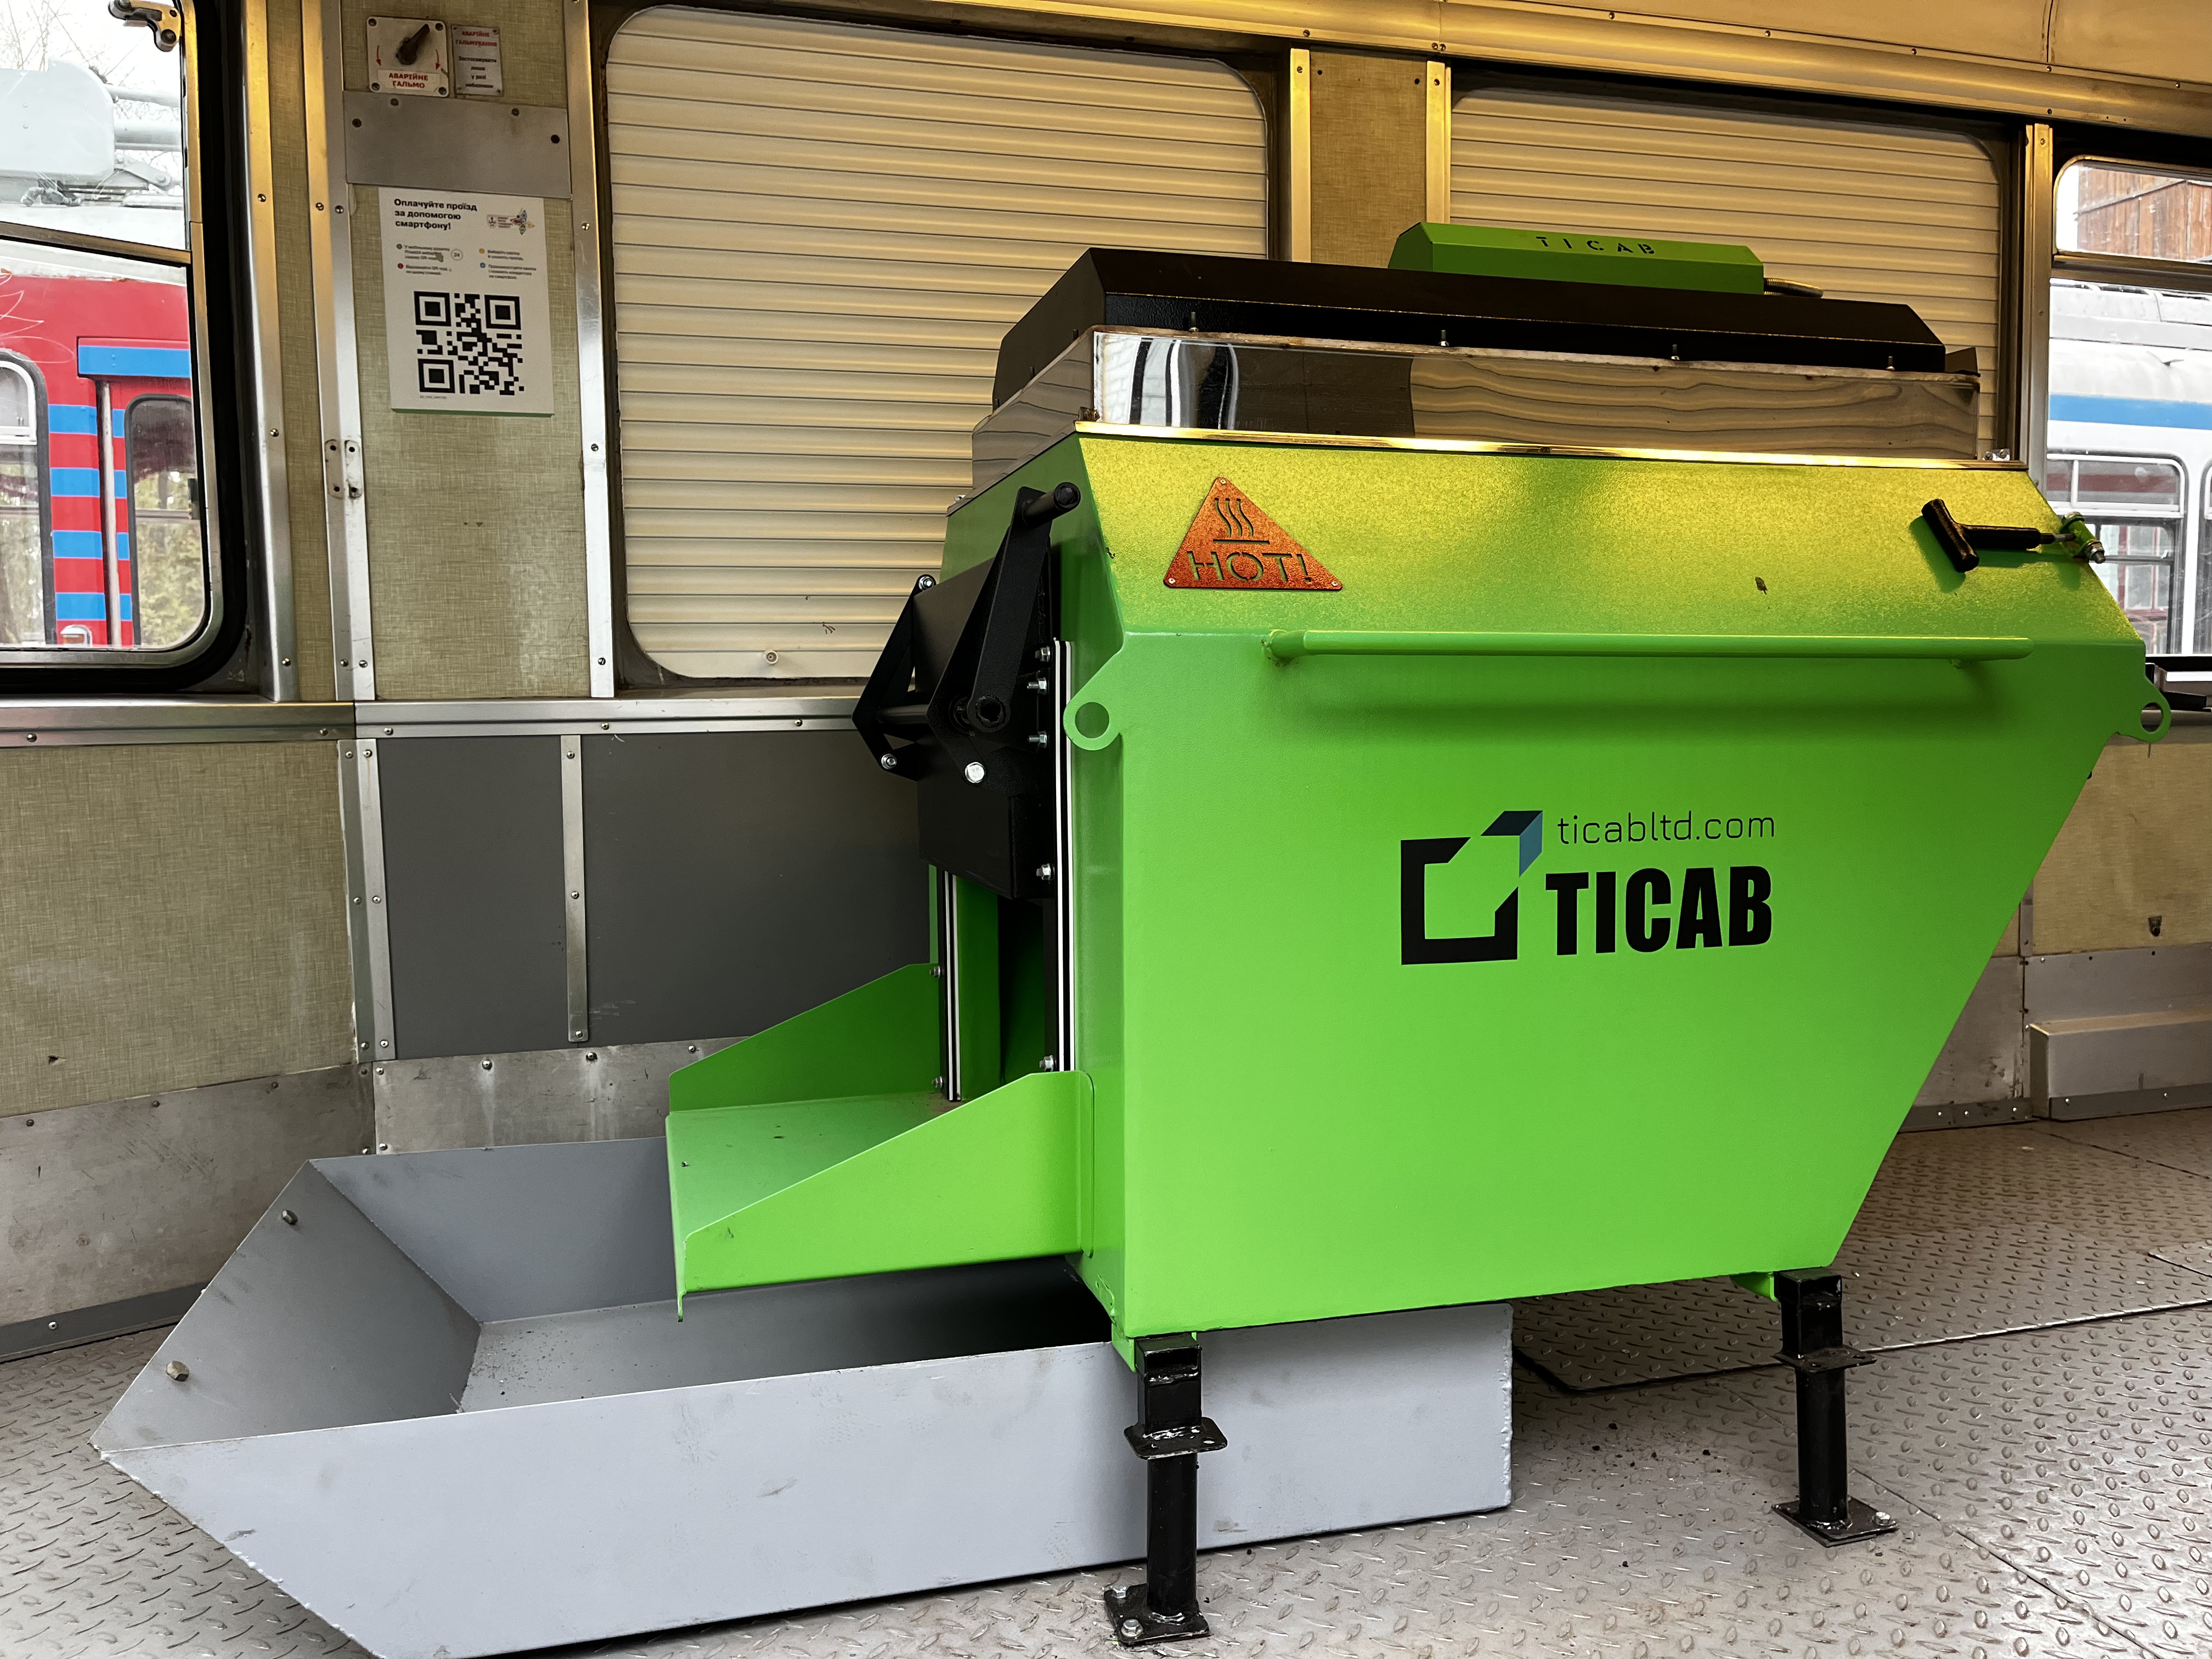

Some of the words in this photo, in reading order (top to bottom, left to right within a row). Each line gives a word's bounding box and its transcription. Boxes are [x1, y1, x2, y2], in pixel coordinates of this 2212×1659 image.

[389, 72, 428, 81] АВАРІЙНЕ
[394, 198, 444, 210] Оплачуйте
[446, 202, 477, 212] проїзд
[407, 211, 461, 219] допомогою
[395, 221, 451, 230] смартфону!
[1536, 236, 1655, 255] TICAB
[1186, 550, 1312, 583] HOT!
[1557, 810, 1775, 845] ticabltd.com
[1545, 865, 1773, 956] TICAB
